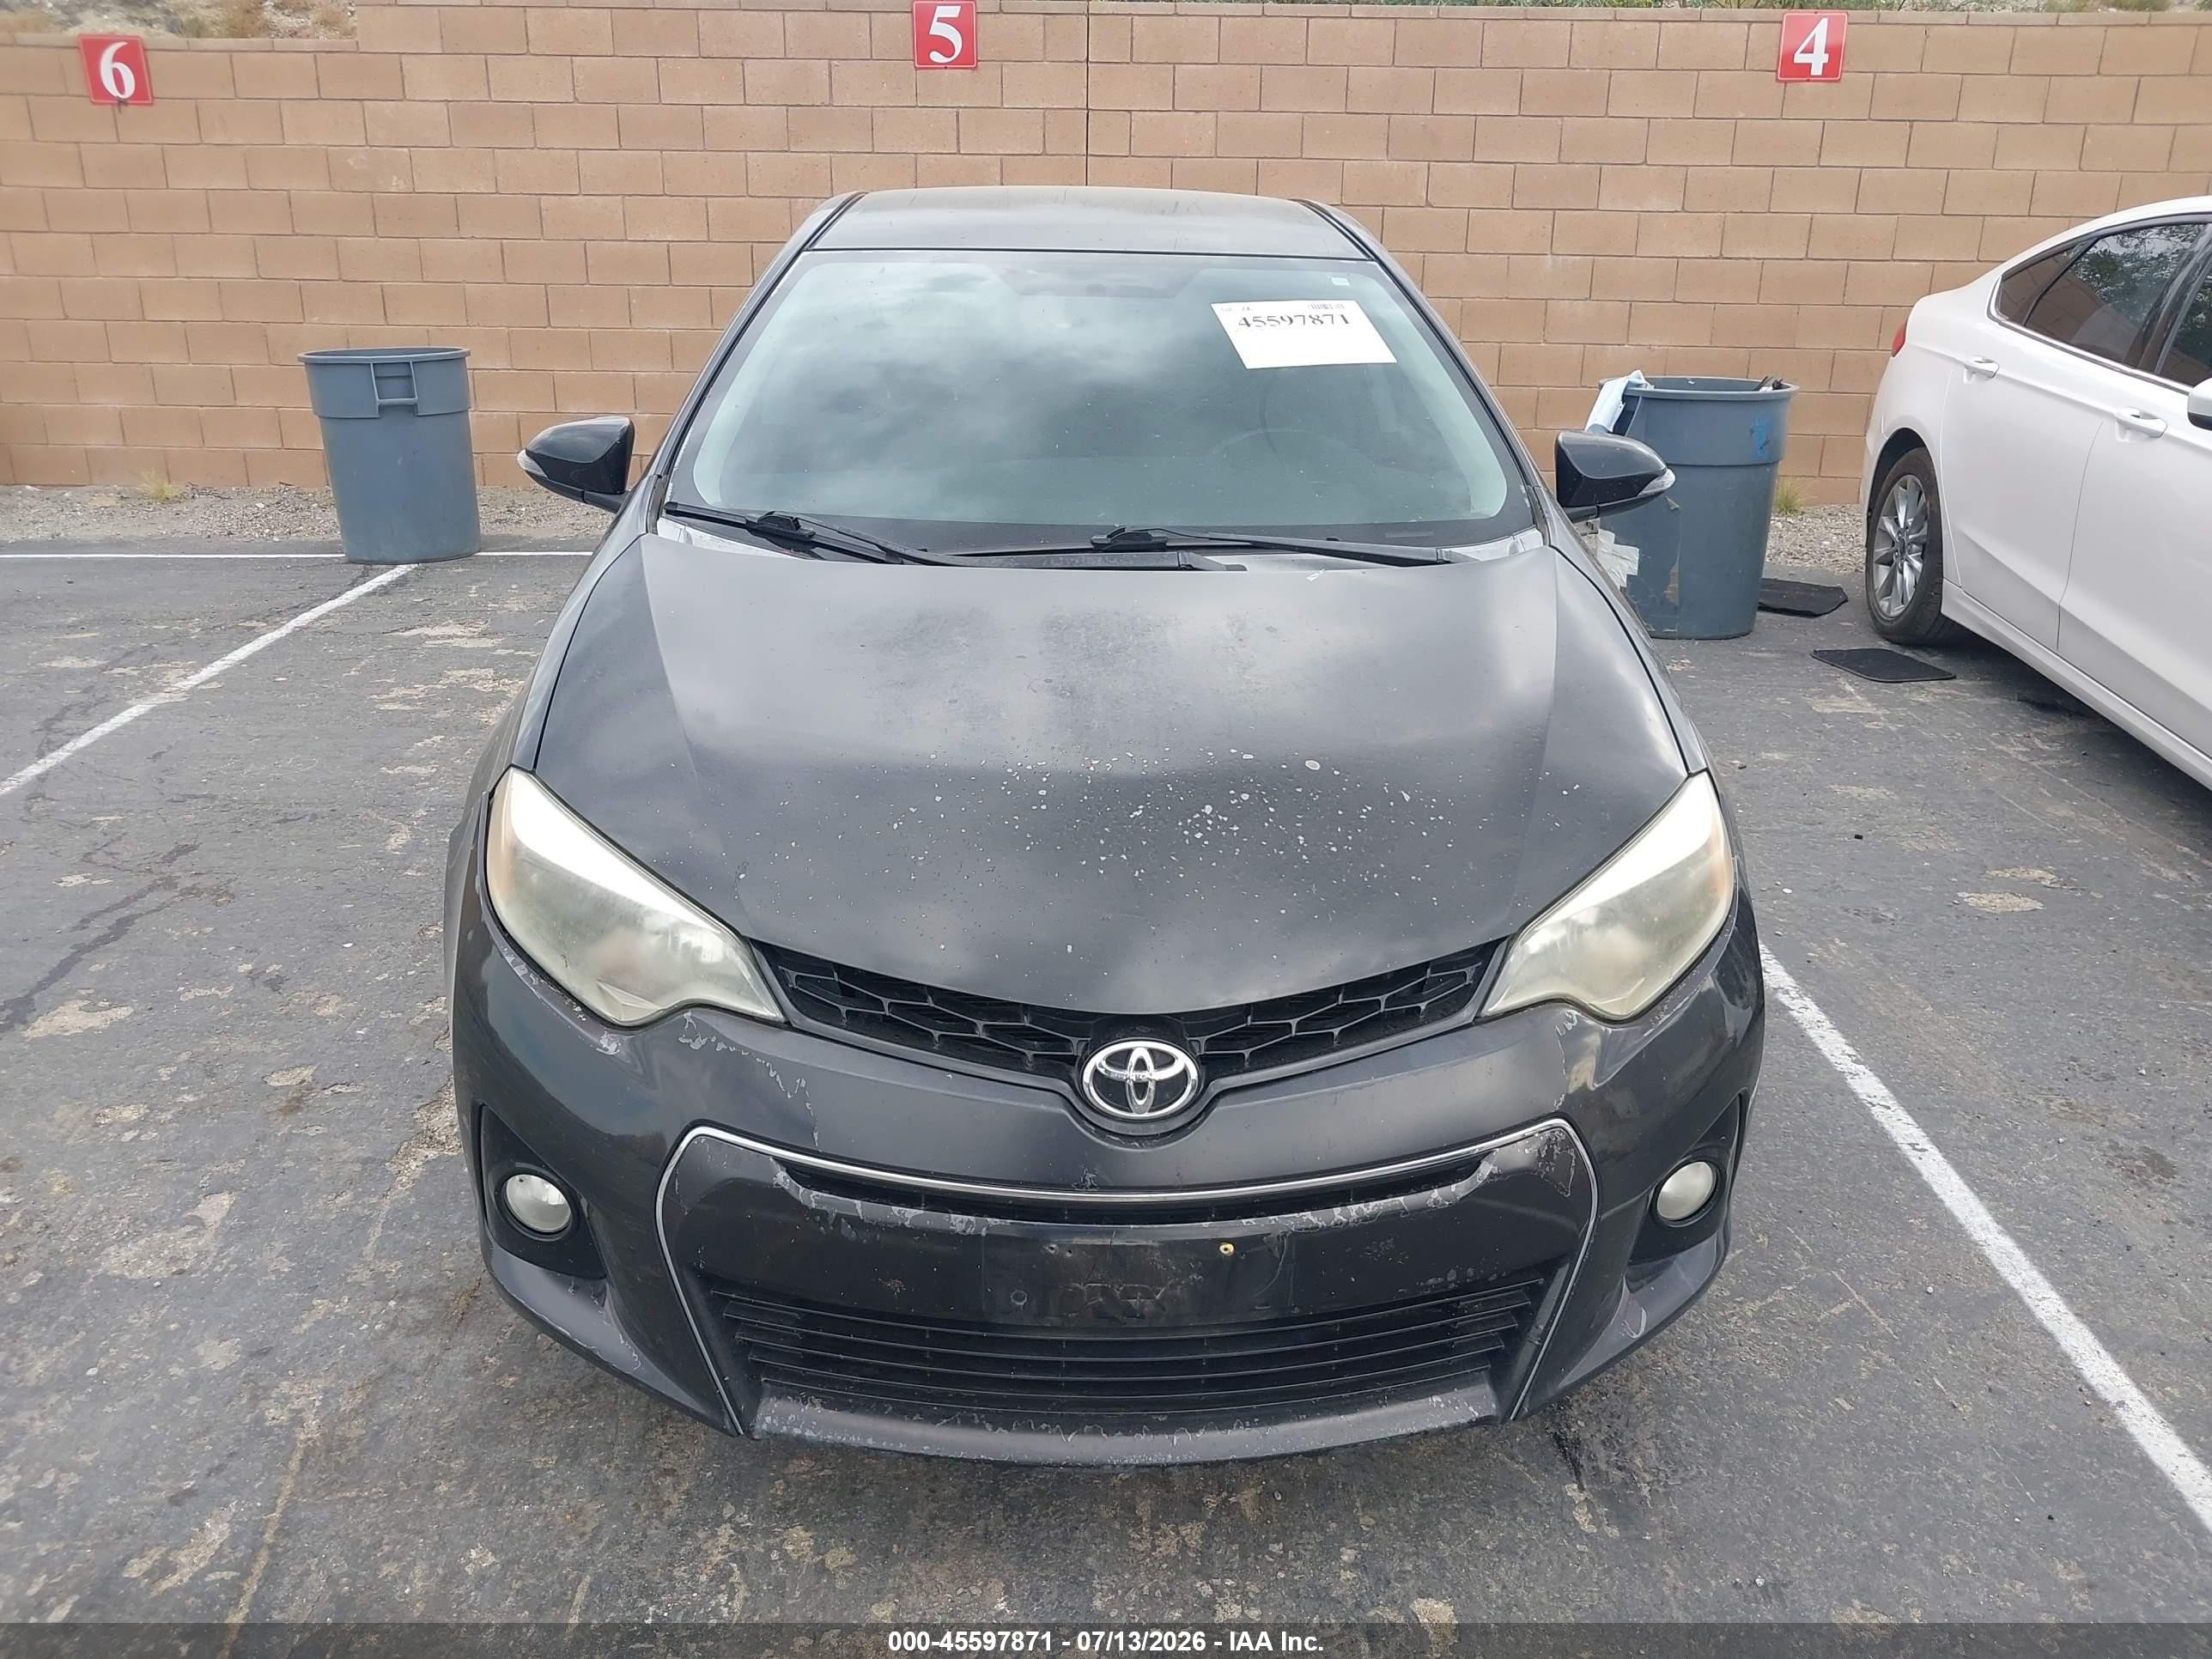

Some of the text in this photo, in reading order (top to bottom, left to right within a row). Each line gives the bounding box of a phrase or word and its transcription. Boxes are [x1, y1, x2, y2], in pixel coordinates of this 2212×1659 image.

[928, 5, 963, 64] 5
[1793, 16, 1829, 76] 4
[100, 41, 136, 100] 6
[1238, 313, 1351, 328] 45597871
